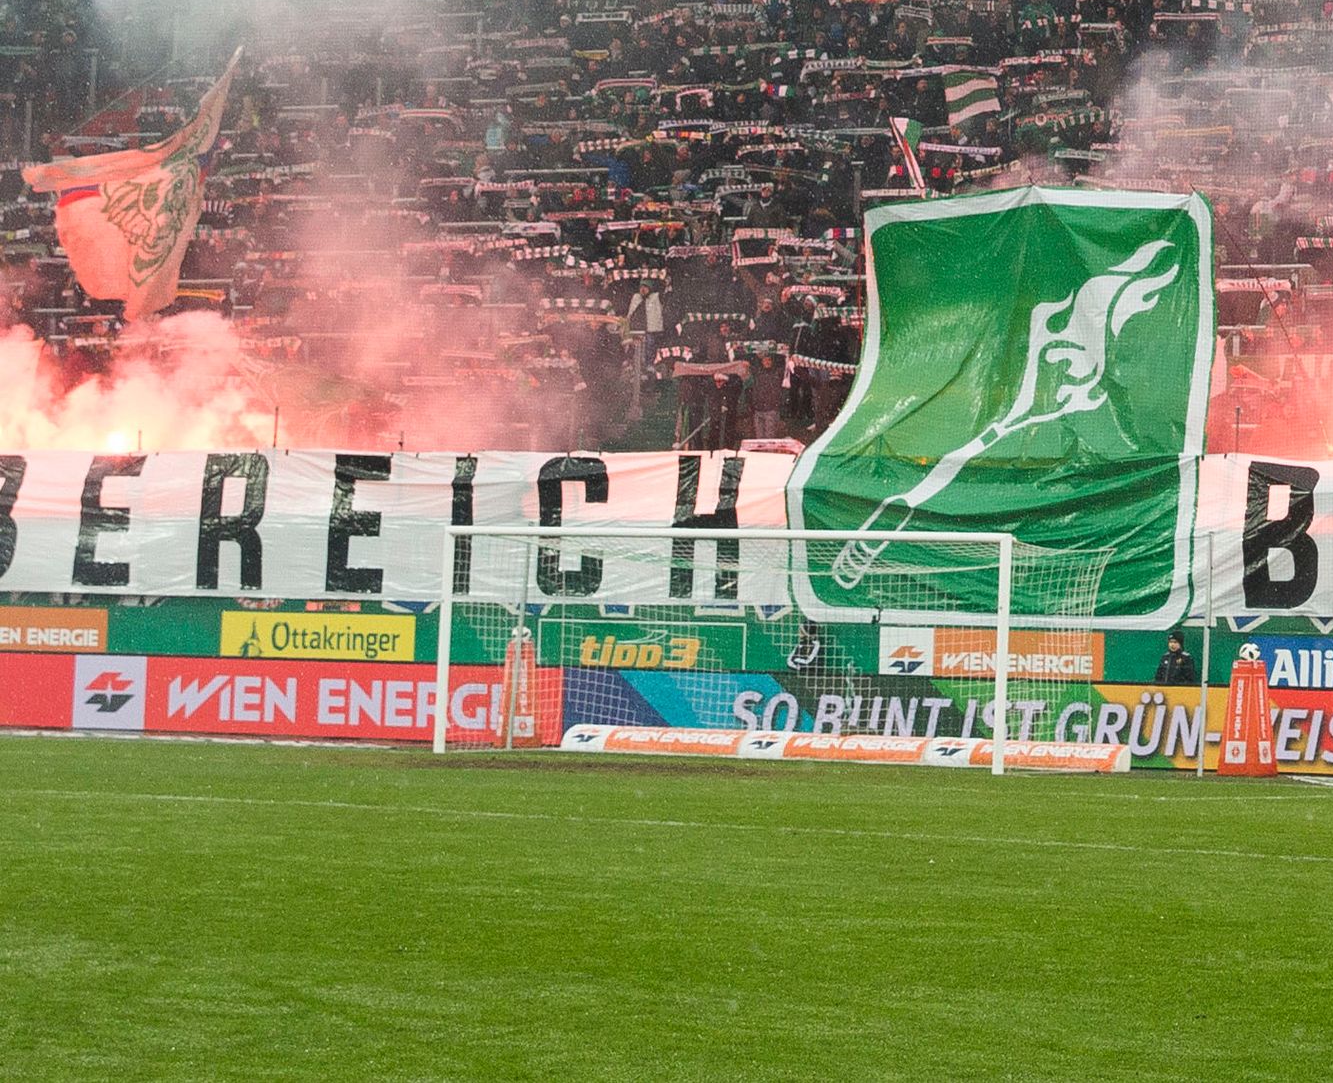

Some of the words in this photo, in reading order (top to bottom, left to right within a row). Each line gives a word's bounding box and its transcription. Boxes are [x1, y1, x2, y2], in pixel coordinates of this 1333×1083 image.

[27, 628, 99, 647] ENERGIE
[271, 622, 400, 659] Ottakringer
[941, 652, 997, 671] WIEN
[1006, 654, 1093, 675] ENERGIE
[168, 674, 297, 724] WIEN
[317, 678, 504, 731] ENERGI
[734, 691, 799, 732] SO
[613, 731, 661, 742] WIEN
[658, 732, 738, 746] ENERGIE
[793, 736, 844, 748] WIEN
[842, 738, 921, 752] ENERGIE
[1030, 745, 1116, 759] ENERGIE
